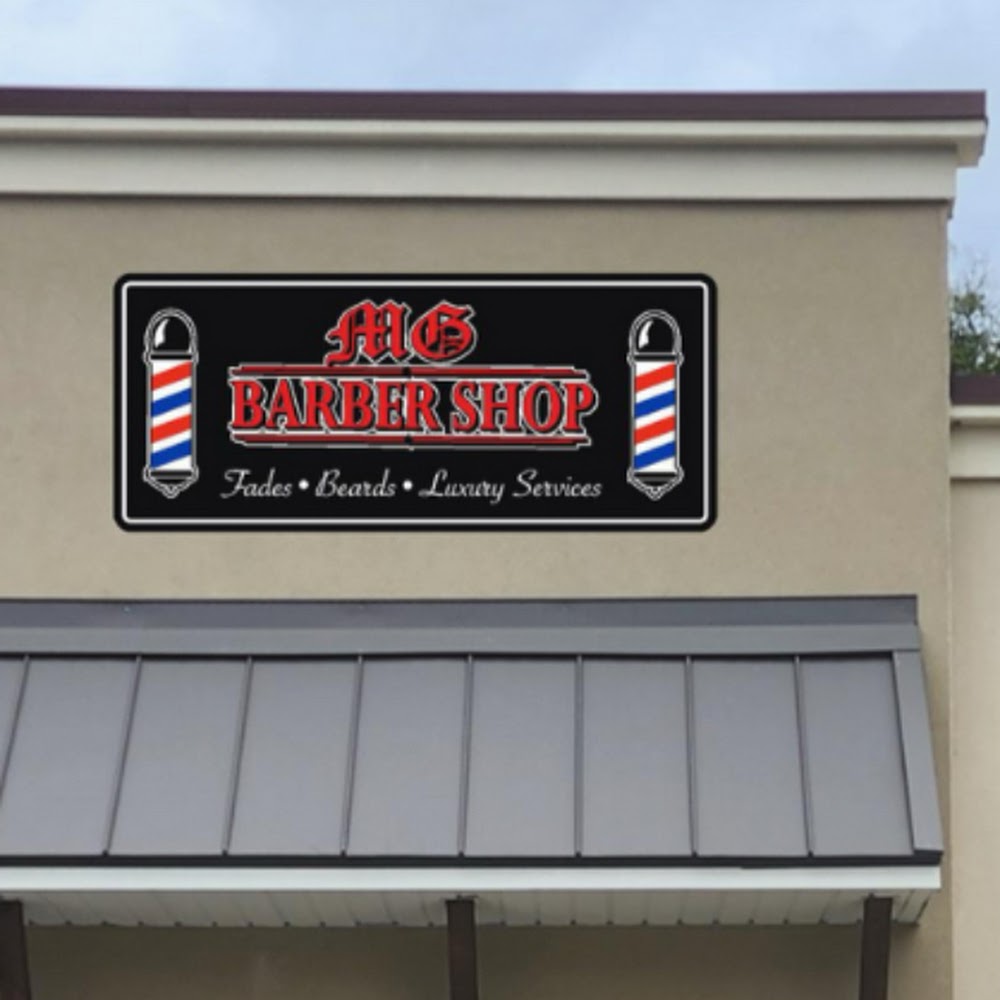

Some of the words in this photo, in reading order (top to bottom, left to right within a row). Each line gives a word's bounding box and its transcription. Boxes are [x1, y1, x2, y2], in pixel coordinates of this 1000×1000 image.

[325, 299, 478, 366] MG
[229, 377, 443, 434] BARBER
[450, 379, 600, 434] SHOP
[220, 468, 293, 498] Fades
[315, 468, 396, 498] Beards
[418, 468, 505, 504] Luxury
[512, 468, 602, 498] Services
